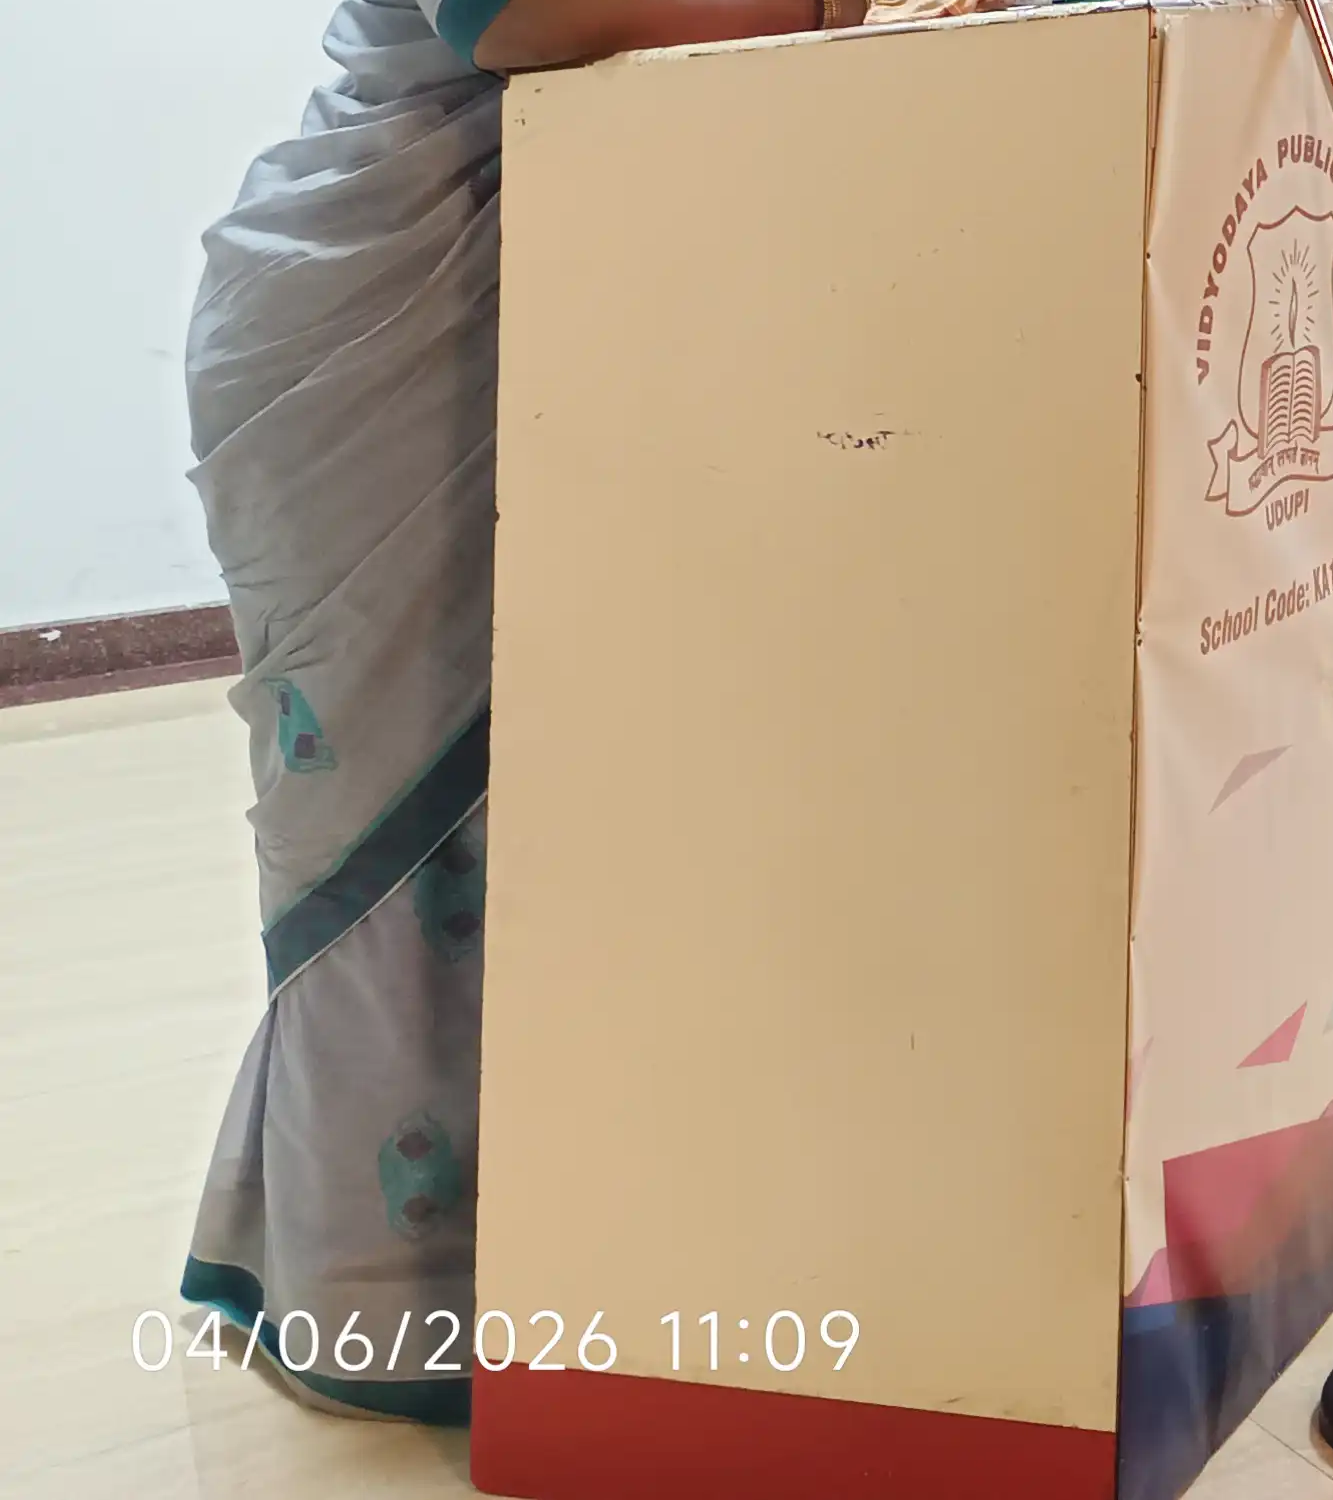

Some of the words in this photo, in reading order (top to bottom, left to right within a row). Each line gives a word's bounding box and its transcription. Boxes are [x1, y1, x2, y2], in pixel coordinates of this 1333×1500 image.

[1196, 158, 1268, 386] VIDYODAYA
[1265, 488, 1309, 531] UDUPI
[1200, 596, 1260, 655] School
[1264, 580, 1310, 626] Code:
